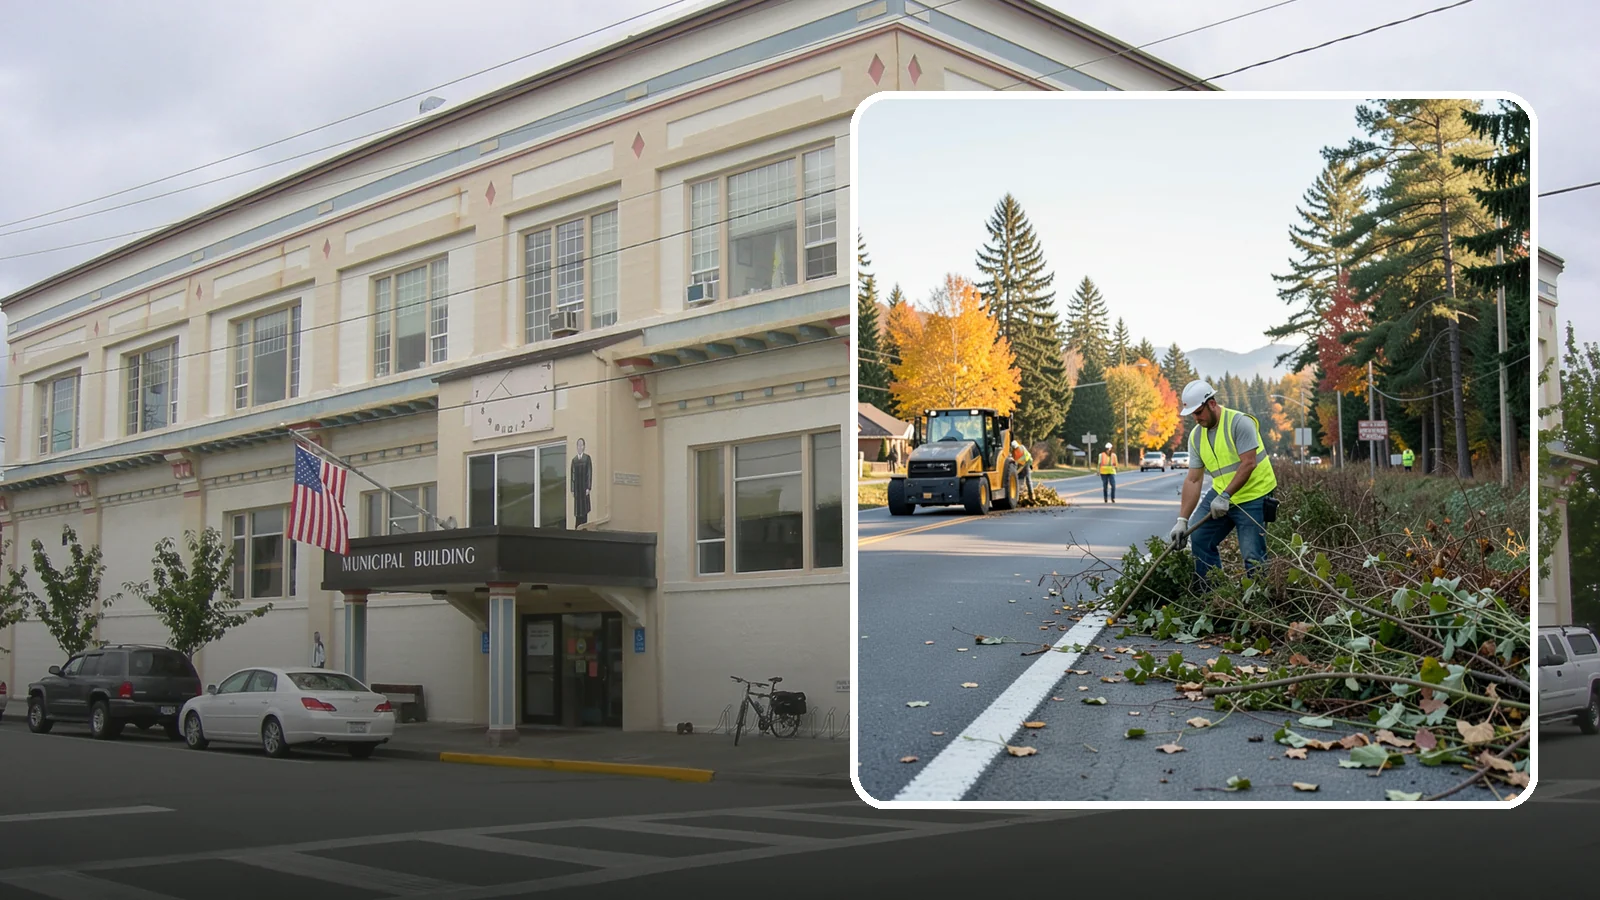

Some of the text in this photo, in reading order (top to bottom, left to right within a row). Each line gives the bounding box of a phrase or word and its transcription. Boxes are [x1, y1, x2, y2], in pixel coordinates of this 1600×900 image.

[480, 407, 485, 415] 8
[487, 417, 492, 426] 9
[528, 414, 533, 422] 3
[494, 423, 500, 432] 10
[521, 420, 526, 428] 2
[501, 425, 506, 433] 11
[507, 425, 513, 433] 12
[342, 546, 475, 572] MUNICIPAL BUILDING
